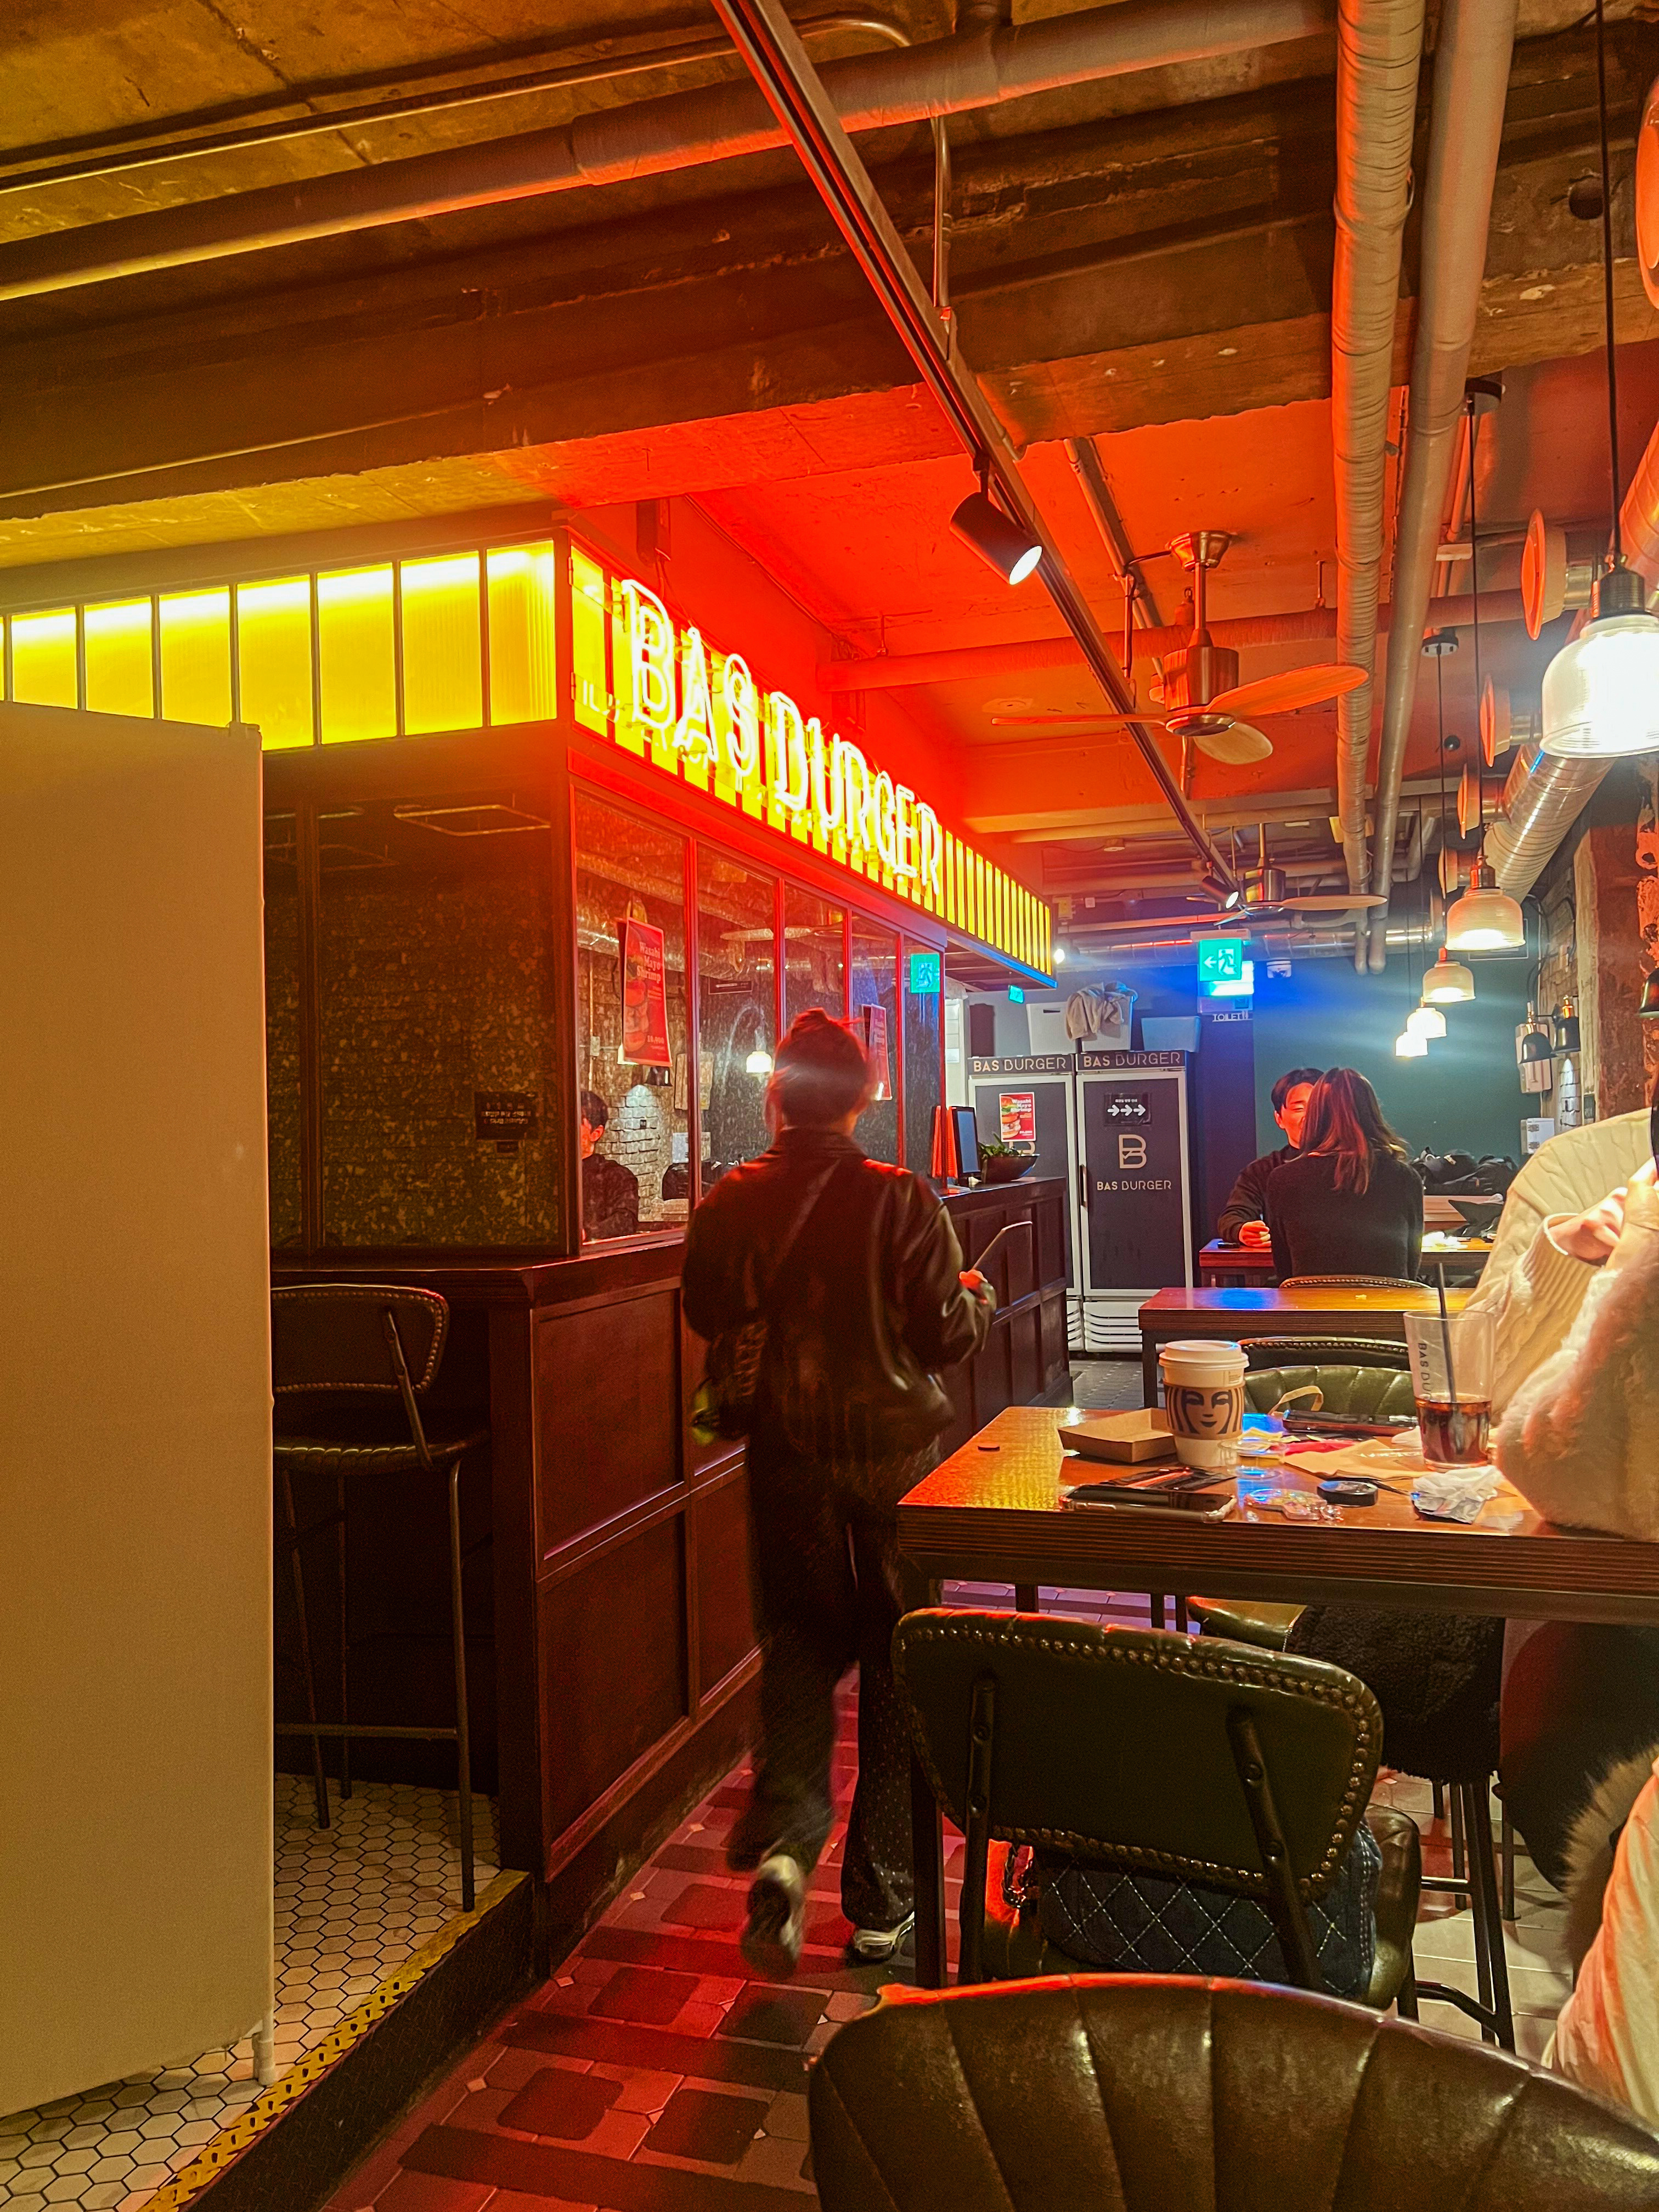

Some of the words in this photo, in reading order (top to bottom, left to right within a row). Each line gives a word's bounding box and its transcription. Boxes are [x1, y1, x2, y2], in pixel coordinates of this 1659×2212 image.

[621, 579, 756, 776] BAS
[639, 941, 661, 959] Wasabi
[644, 955, 661, 972] Mayo
[636, 965, 661, 984] Shrimp
[1212, 1013, 1242, 1021] TOILET
[973, 1059, 1000, 1072] BAS
[1004, 1057, 1066, 1071] BURGER
[1084, 1056, 1110, 1068] BAS
[1115, 1052, 1181, 1066] BURGER
[1097, 1181, 1118, 1190] BAS
[1121, 1180, 1172, 1190] BURGER
[1418, 1342, 1429, 1367] BAS
